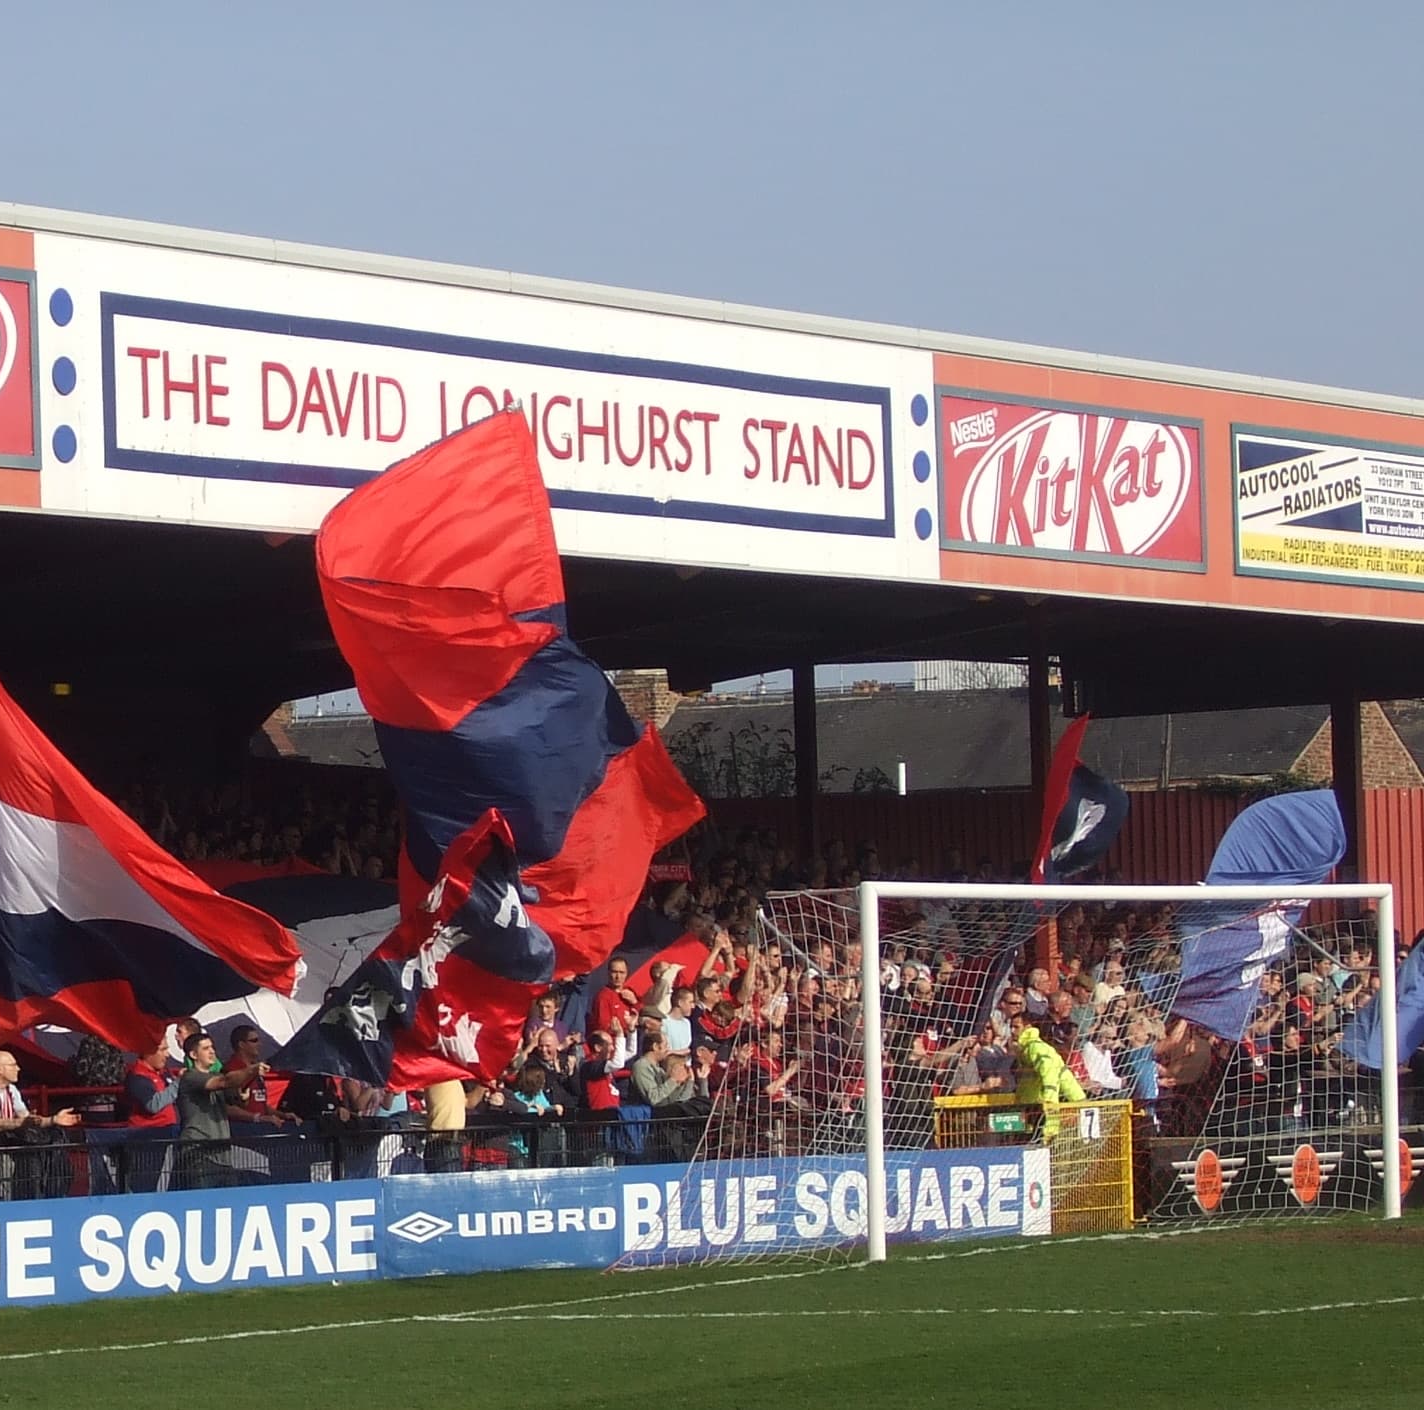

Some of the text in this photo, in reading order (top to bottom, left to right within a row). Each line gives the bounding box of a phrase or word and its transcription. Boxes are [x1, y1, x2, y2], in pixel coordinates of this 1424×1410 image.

[127, 346, 230, 428] THE
[260, 361, 407, 443] DAVID
[743, 417, 876, 491] STAND
[1239, 460, 1318, 500] AUTOCOOL
[1284, 476, 1362, 516] RADIATORS
[1243, 547, 1287, 563] INDUSTRIAL
[1289, 552, 1309, 566] HEAT
[1311, 554, 1359, 570] EXCHANGERS
[1366, 560, 1384, 572] FUEL
[1386, 561, 1408, 575] TANKS
[1284, 538, 1326, 553] RADIATORS
[1333, 542, 1346, 554] OIL
[1348, 544, 1382, 558] COOLERS
[1085, 1110, 1095, 1140] 7
[458, 1206, 616, 1237] UMBRO
[623, 1163, 1021, 1252] BLUE SQUARE
[78, 1199, 377, 1293] SQUARE
